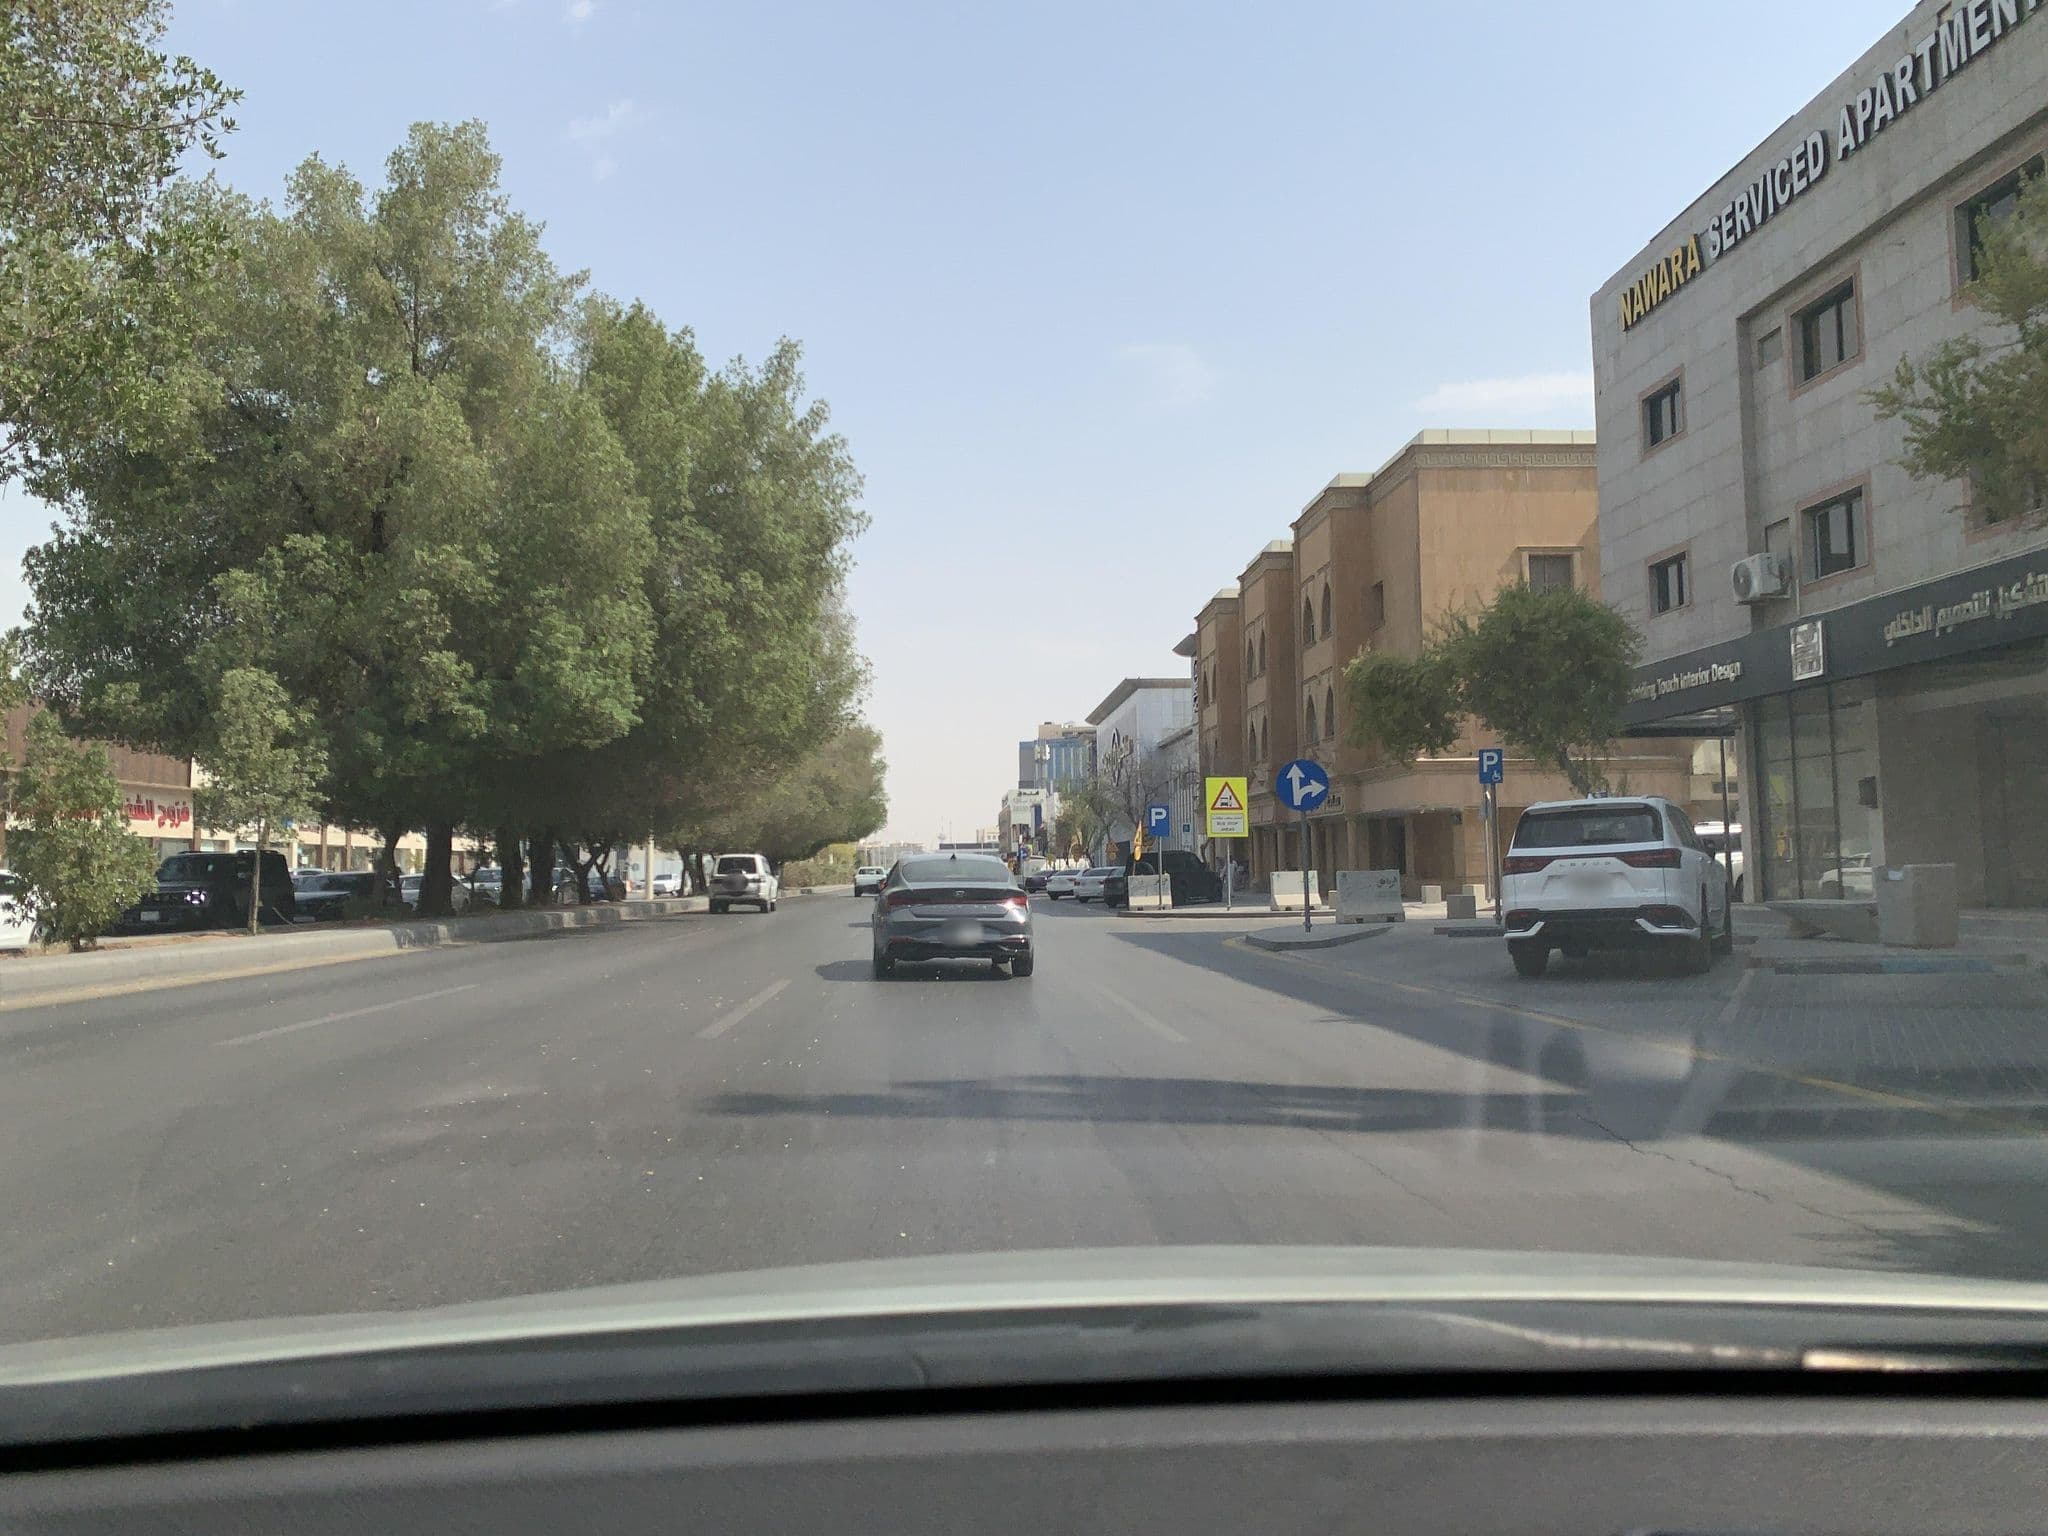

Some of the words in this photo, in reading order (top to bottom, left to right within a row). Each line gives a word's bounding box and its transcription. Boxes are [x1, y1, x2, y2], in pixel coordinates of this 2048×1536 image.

[1618, 234, 1701, 331] NAWARA
[1706, 129, 1826, 259] SERVICED
[1837, 0, 2037, 160] APARTMEN
[1657, 673, 1679, 695] Touch
[1680, 667, 1710, 689] Interior
[1711, 661, 1741, 683] Design
[1482, 752, 1498, 773] P
[1150, 807, 1167, 827] P
